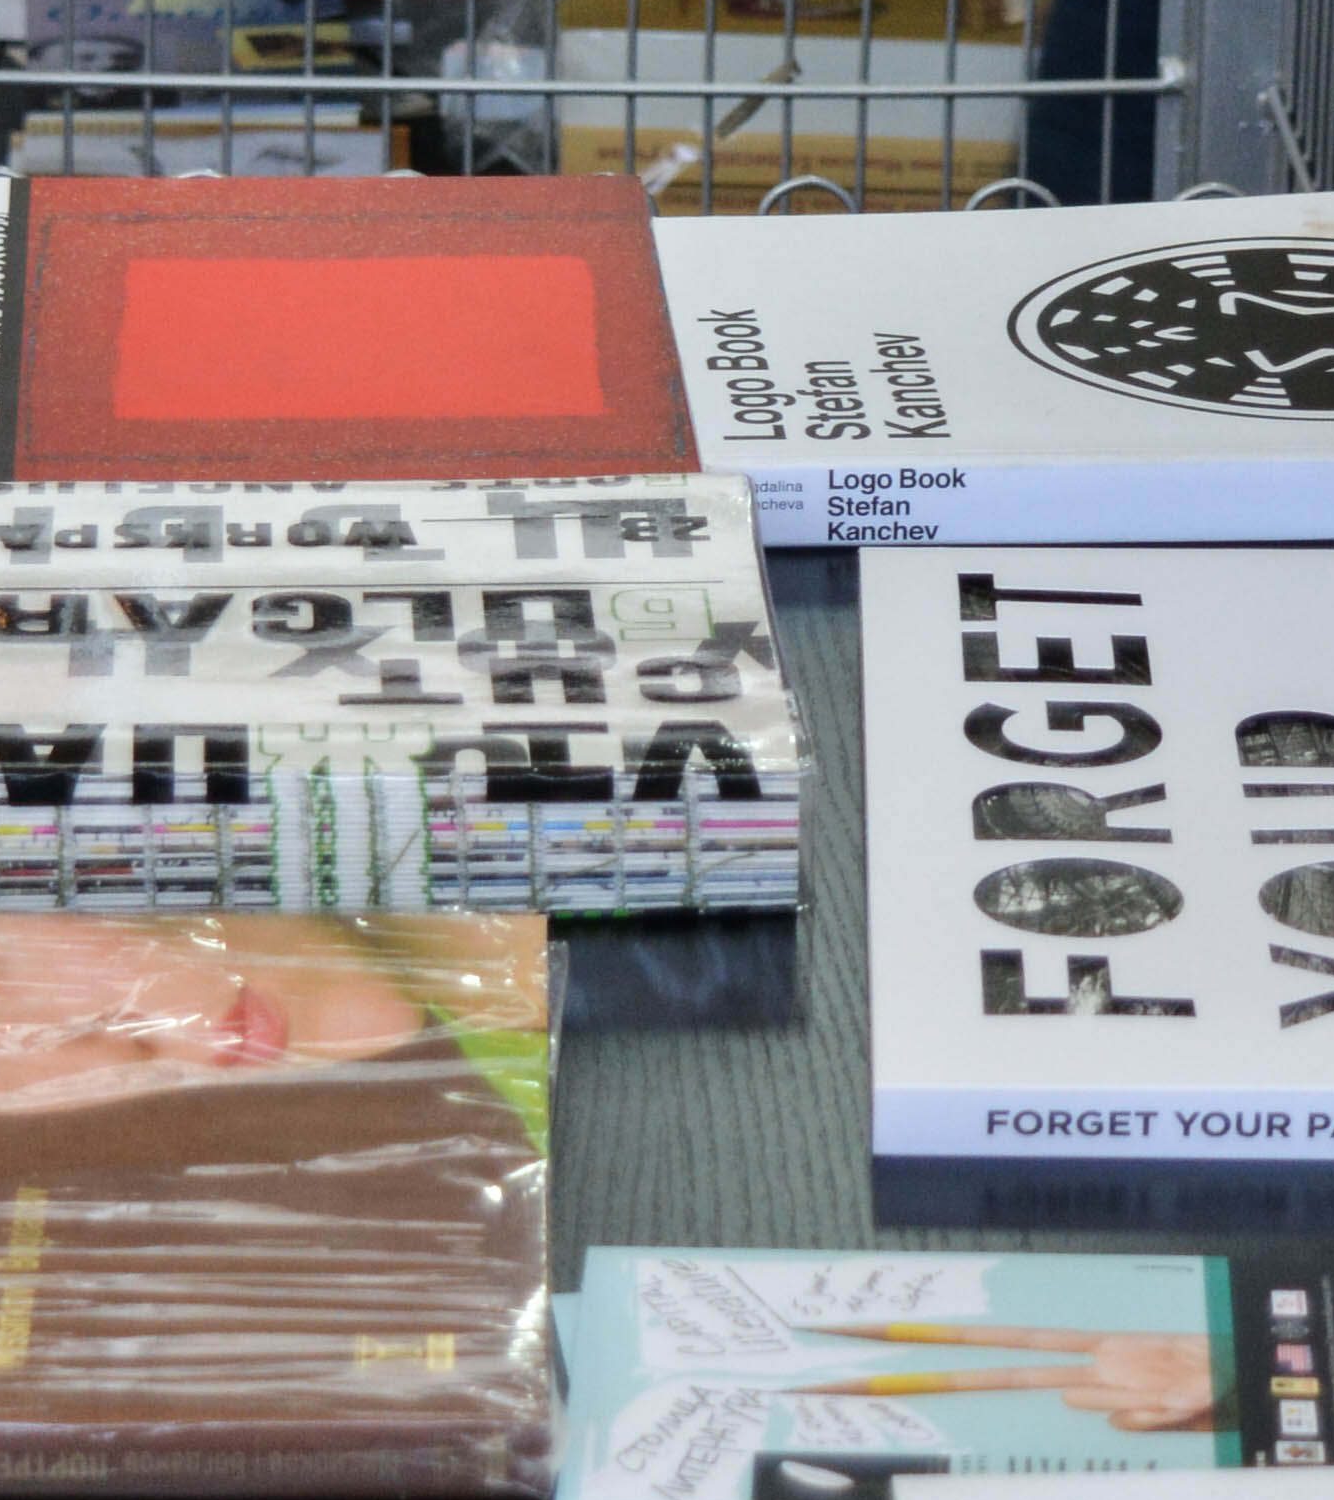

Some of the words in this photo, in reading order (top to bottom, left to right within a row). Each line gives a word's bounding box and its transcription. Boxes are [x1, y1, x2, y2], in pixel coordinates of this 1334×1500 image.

[698, 308, 772, 372] Book
[723, 376, 798, 442] Logo
[796, 359, 872, 441] Stefan
[869, 331, 952, 439] Kanchev
[827, 468, 893, 493] Logo
[899, 467, 967, 490] Book
[827, 496, 911, 517] Stefan
[827, 521, 939, 542] Kanchev
[957, 572, 1198, 1019] FORGET
[985, 1108, 1160, 1138] FORGET
[1174, 1109, 1292, 1140] YOUR
